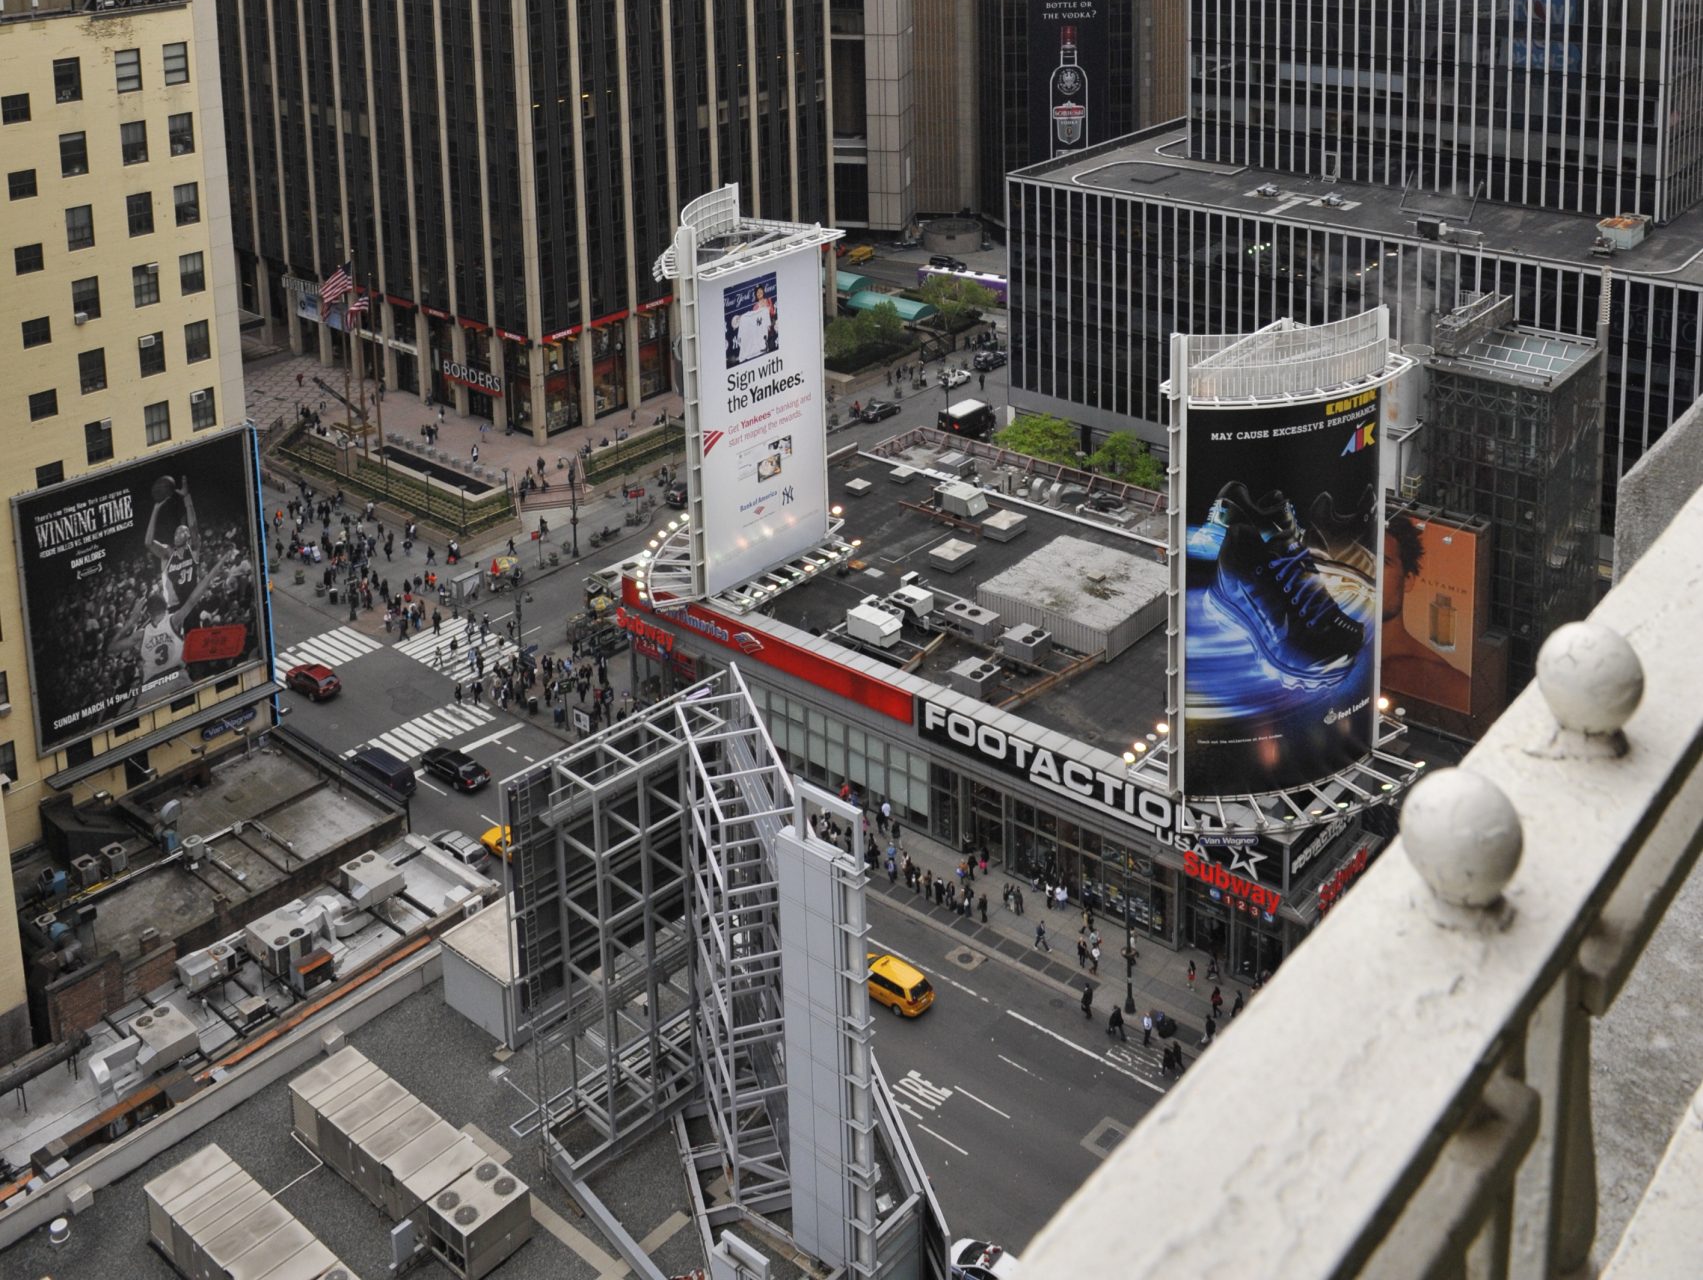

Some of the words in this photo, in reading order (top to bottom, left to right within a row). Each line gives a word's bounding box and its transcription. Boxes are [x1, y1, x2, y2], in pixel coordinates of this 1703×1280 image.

[1043, 12, 1059, 20] THE
[1062, 9, 1097, 20] VODKA?
[1046, 1, 1078, 9] BOTTLE
[443, 360, 501, 392] BORDERS
[727, 370, 756, 392] Sign
[758, 356, 783, 379] with
[727, 395, 748, 414] the
[749, 372, 805, 404] Yankees.
[1210, 432, 1233, 441] MAY
[1236, 429, 1270, 440] CAUSE
[1272, 421, 1325, 437] EXCESSIVE
[740, 502, 753, 512] Bank
[758, 490, 778, 503] America
[34, 507, 97, 549] WINNING
[98, 494, 134, 528] TIME
[70, 557, 84, 569] DAN
[83, 548, 106, 564] KLORES
[154, 643, 169, 666] 3
[53, 711, 80, 730] SUNDAY
[81, 702, 105, 719] MARCH
[106, 697, 114, 707] 14
[1338, 707, 1352, 720] Foot
[1352, 696, 1370, 713] Locker
[925, 701, 1211, 839] FOOTACTION
[1156, 825, 1210, 862] USA
[1204, 836, 1221, 845] Van
[1222, 836, 1255, 846] Wagner
[1183, 850, 1281, 915] Subway
